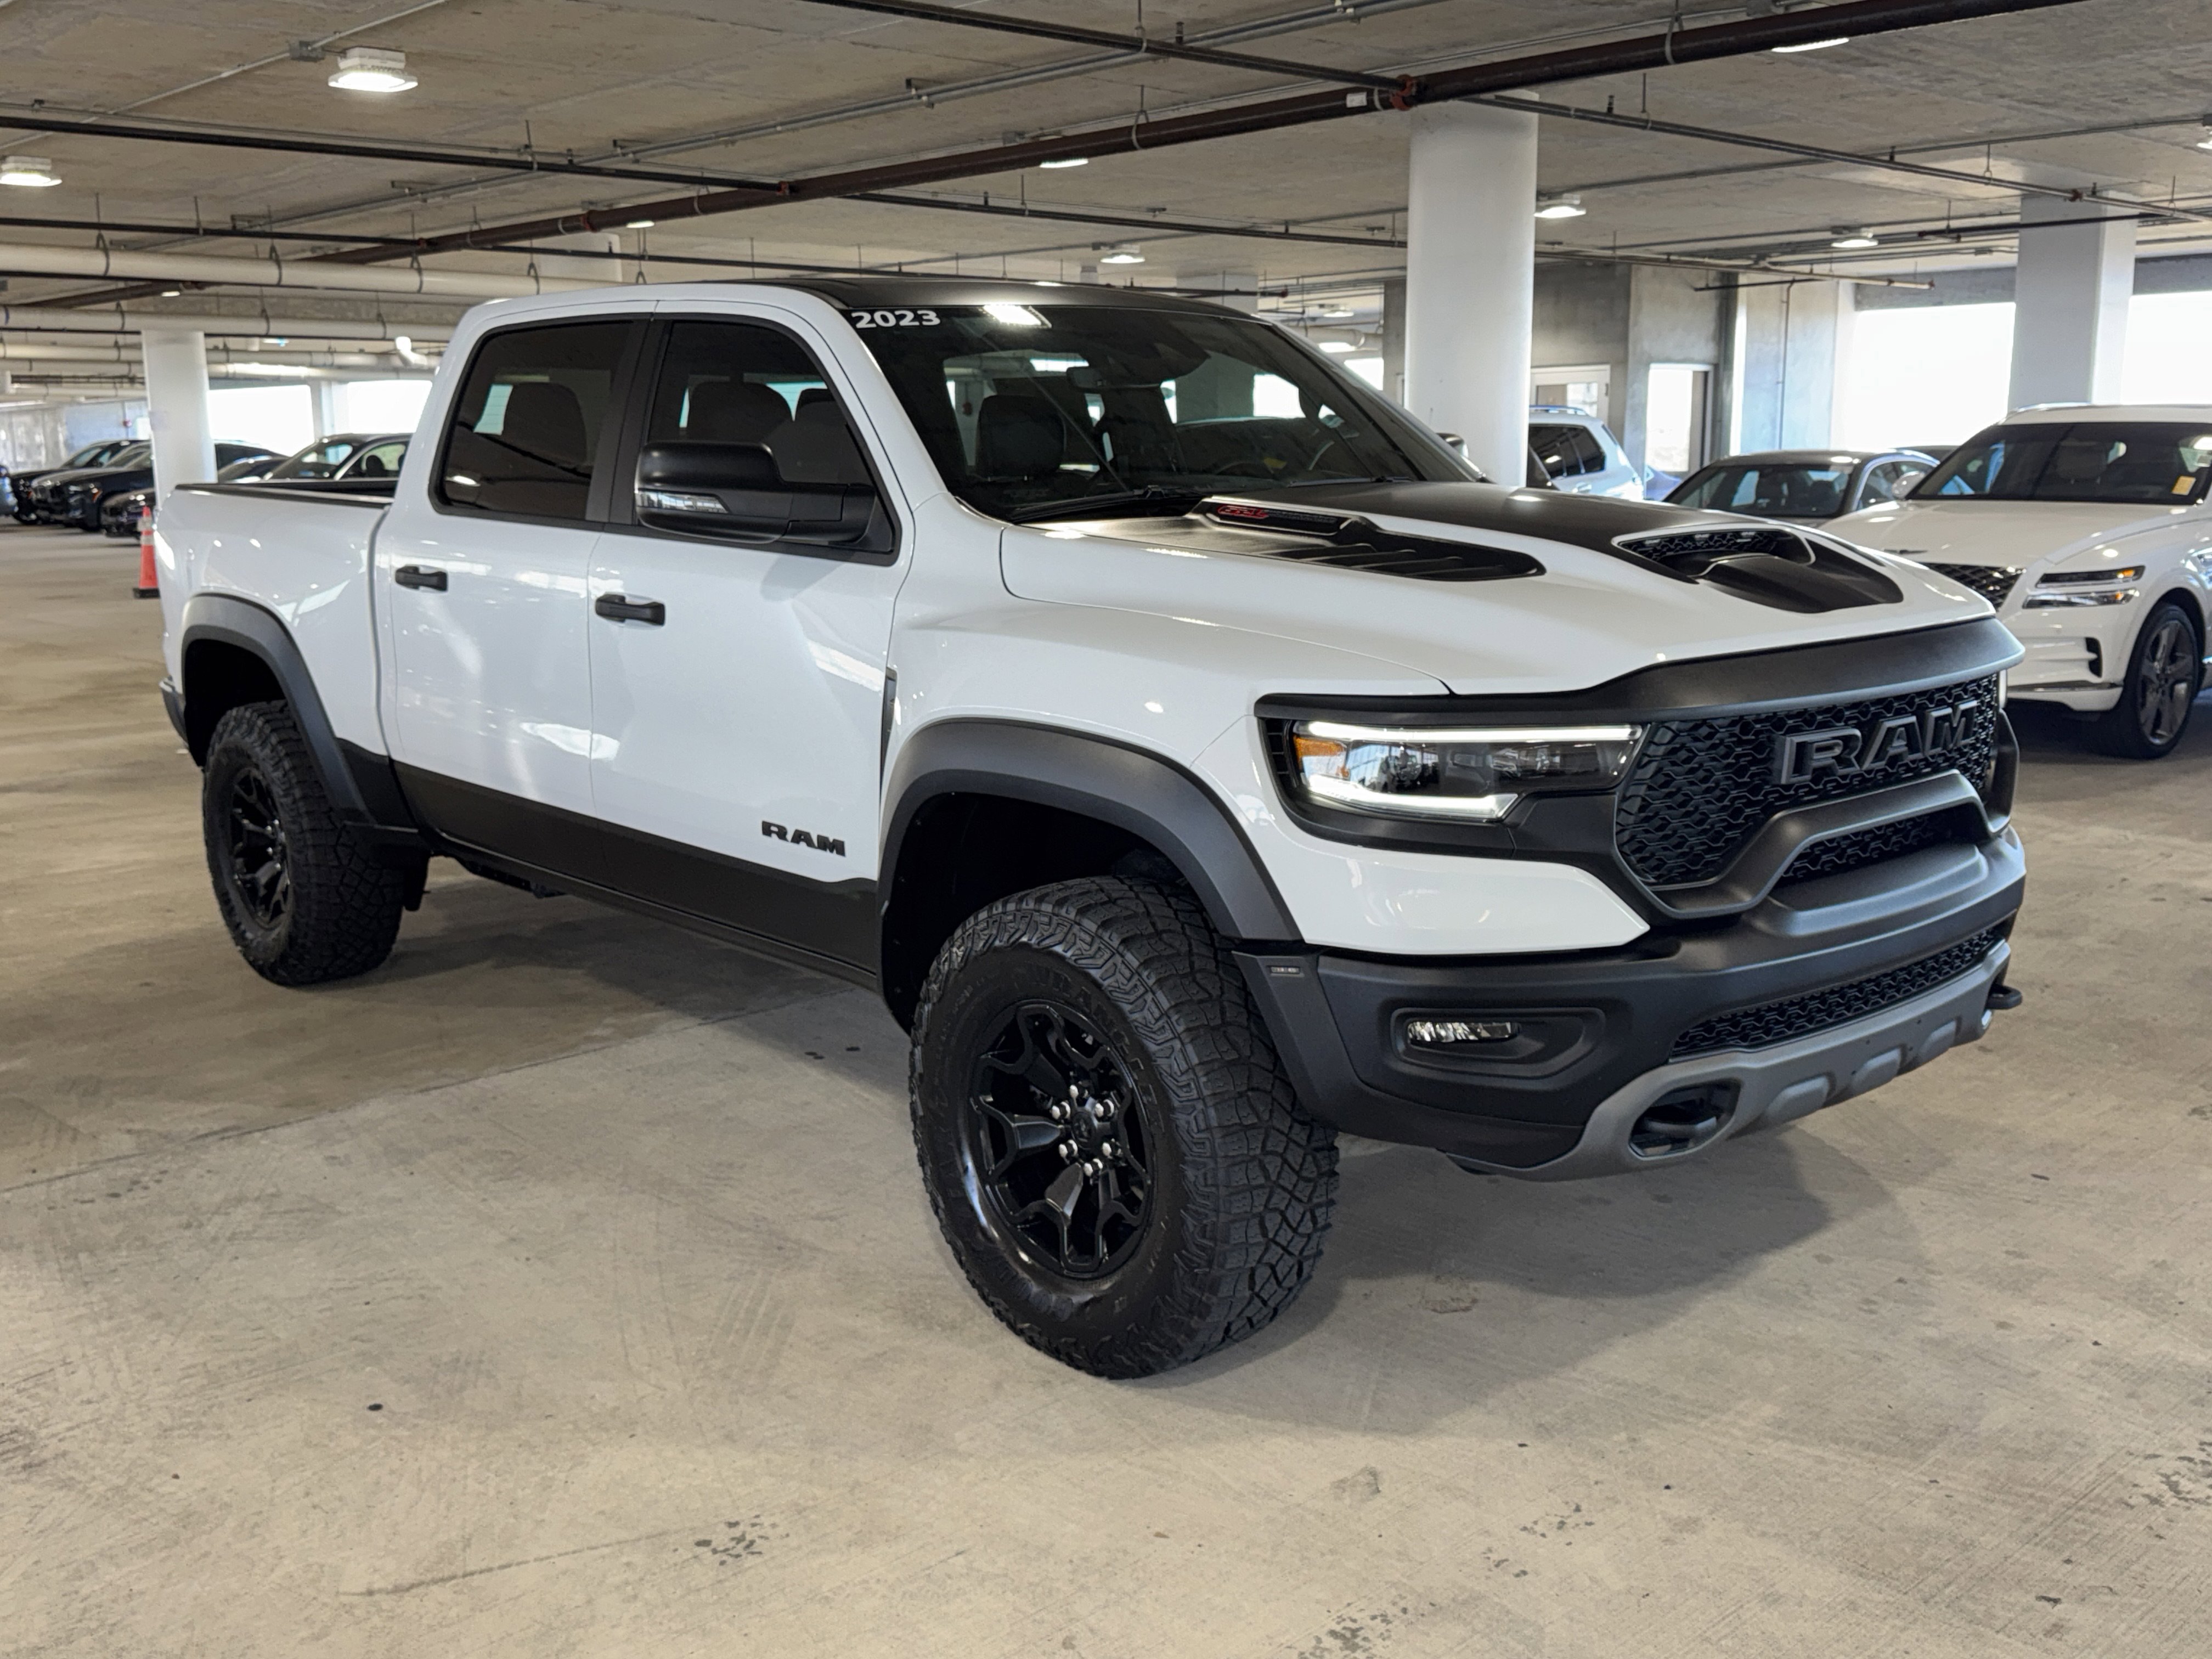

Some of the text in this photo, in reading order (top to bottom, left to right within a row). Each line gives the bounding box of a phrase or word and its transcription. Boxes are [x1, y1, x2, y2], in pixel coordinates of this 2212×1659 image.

[851, 310, 940, 329] 2023
[1781, 700, 1978, 785] RAM
[762, 821, 846, 857] RAM
